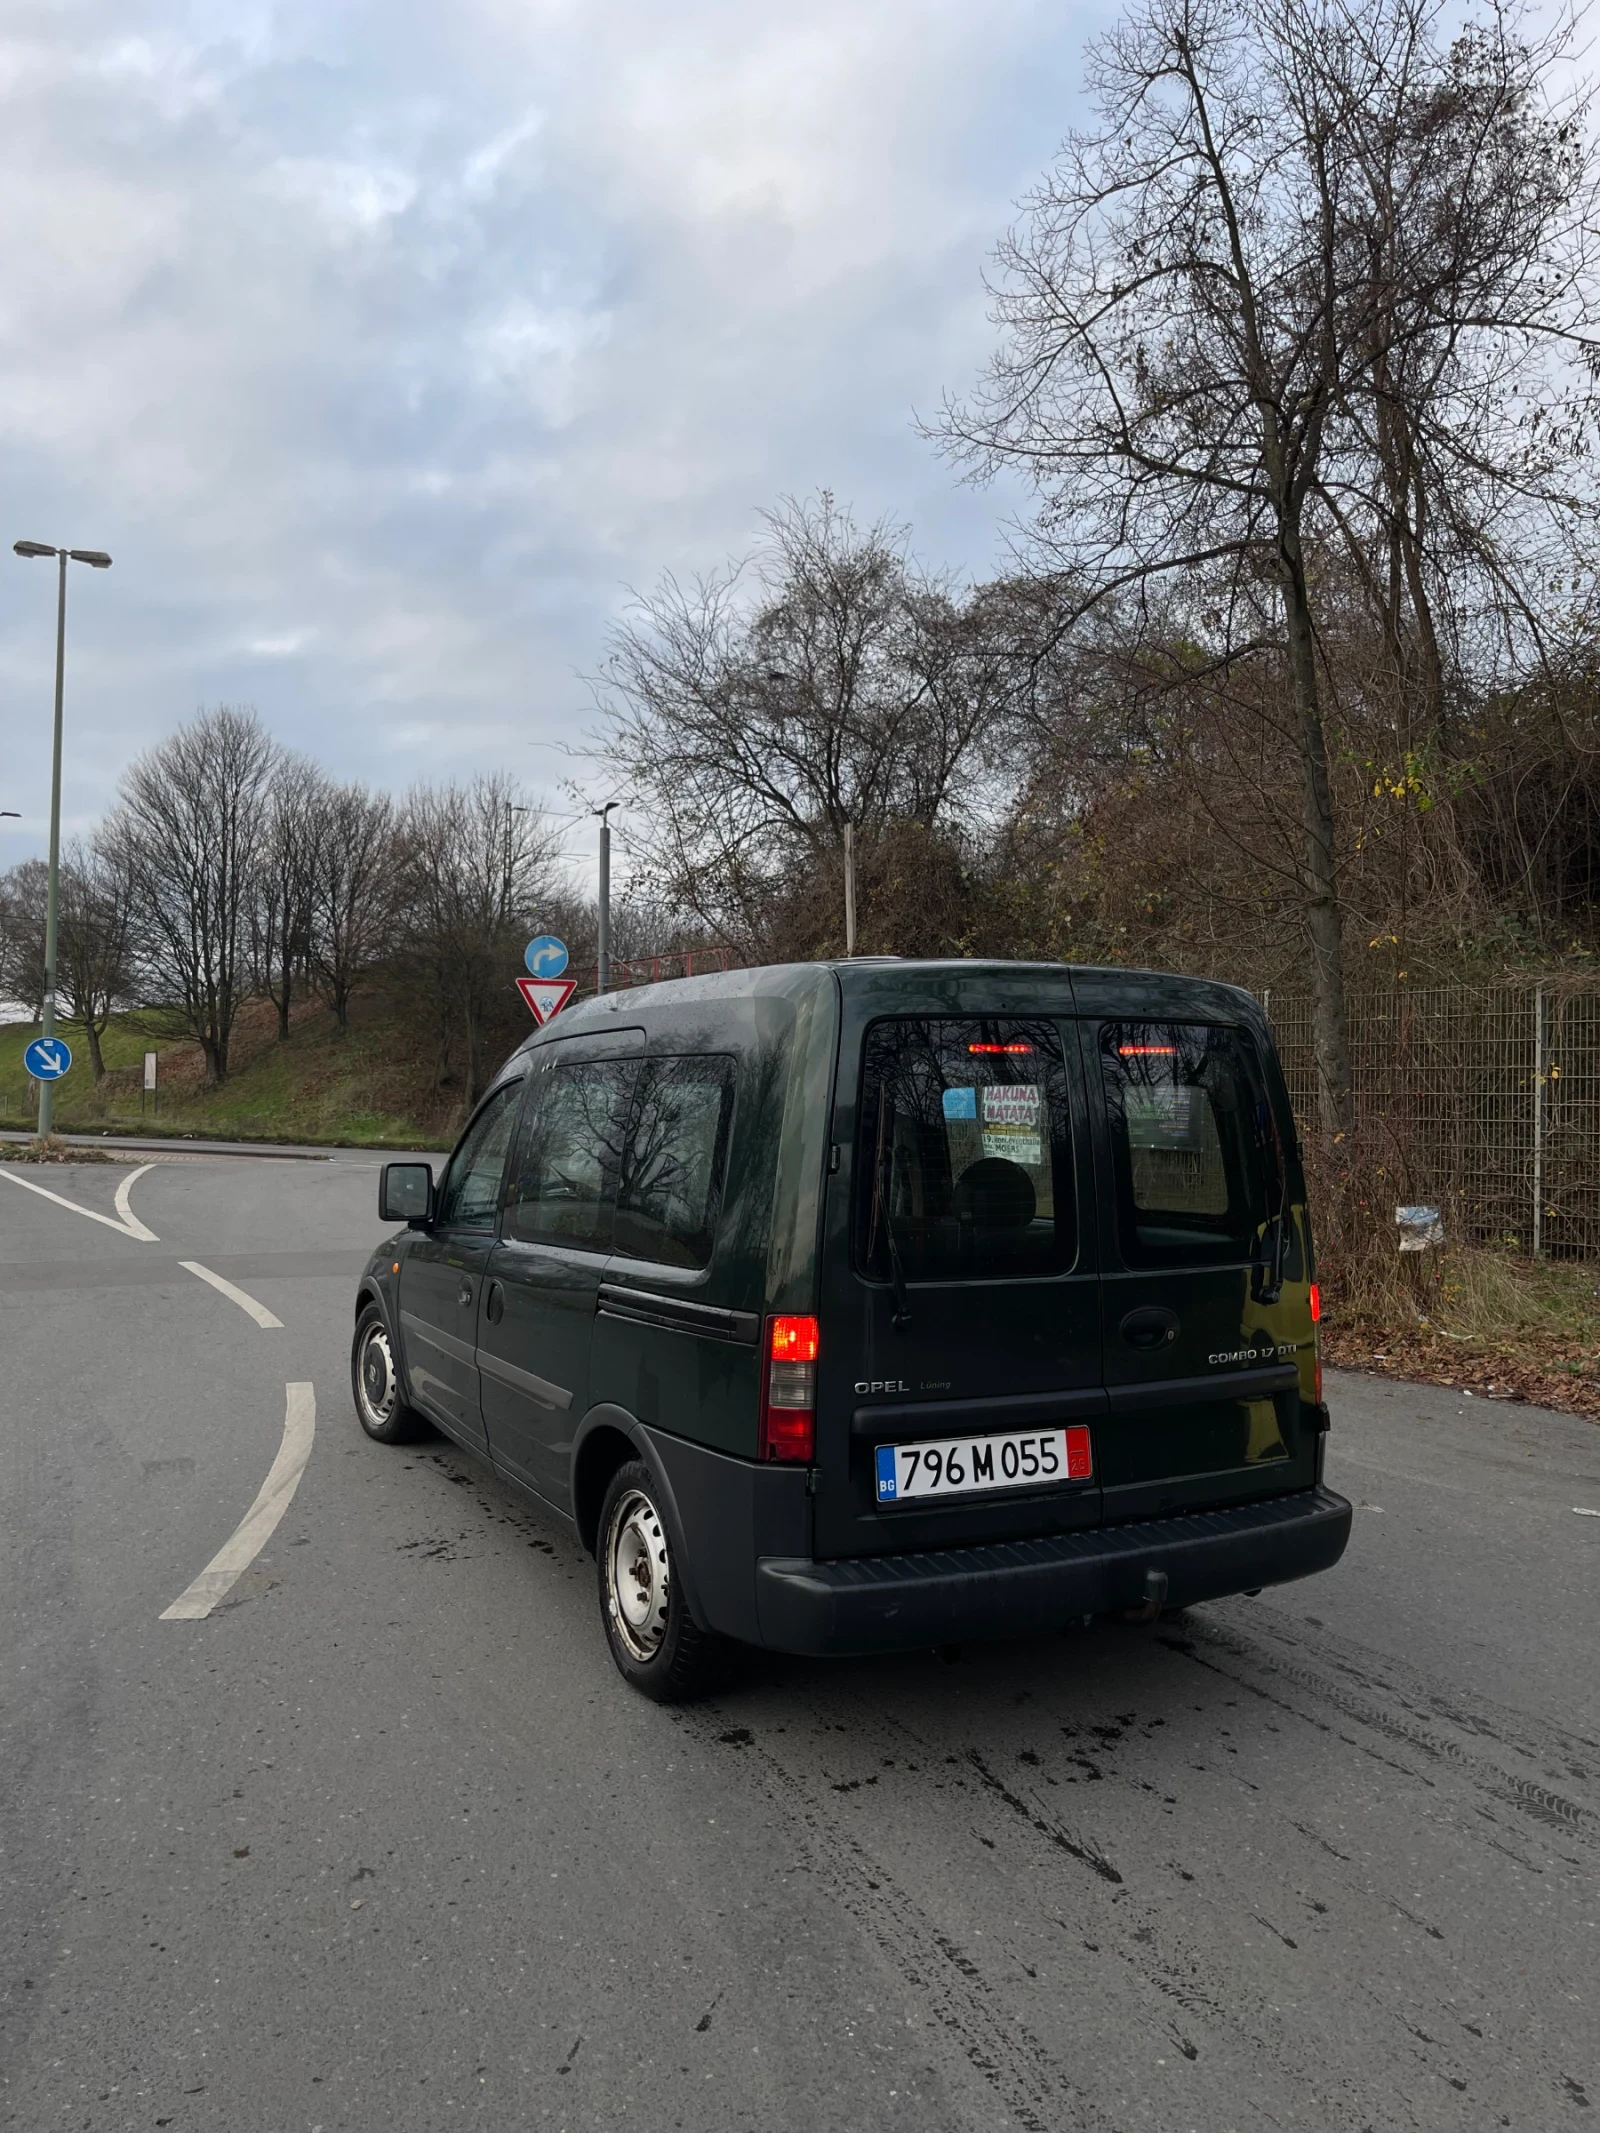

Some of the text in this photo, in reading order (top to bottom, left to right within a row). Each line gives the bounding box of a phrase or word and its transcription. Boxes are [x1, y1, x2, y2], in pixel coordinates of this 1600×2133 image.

[986, 1087, 1036, 1104] HAKUNA
[987, 1105, 1033, 1122] MATATA
[995, 1144, 1019, 1153] MOERS
[1208, 1349, 1257, 1364] COMBO
[1277, 1344, 1297, 1356] DTI
[854, 1380, 910, 1394] OPEL
[920, 1381, 951, 1390] Lüning
[901, 1437, 1059, 1491] 796 M 055
[880, 1479, 895, 1492] BG
